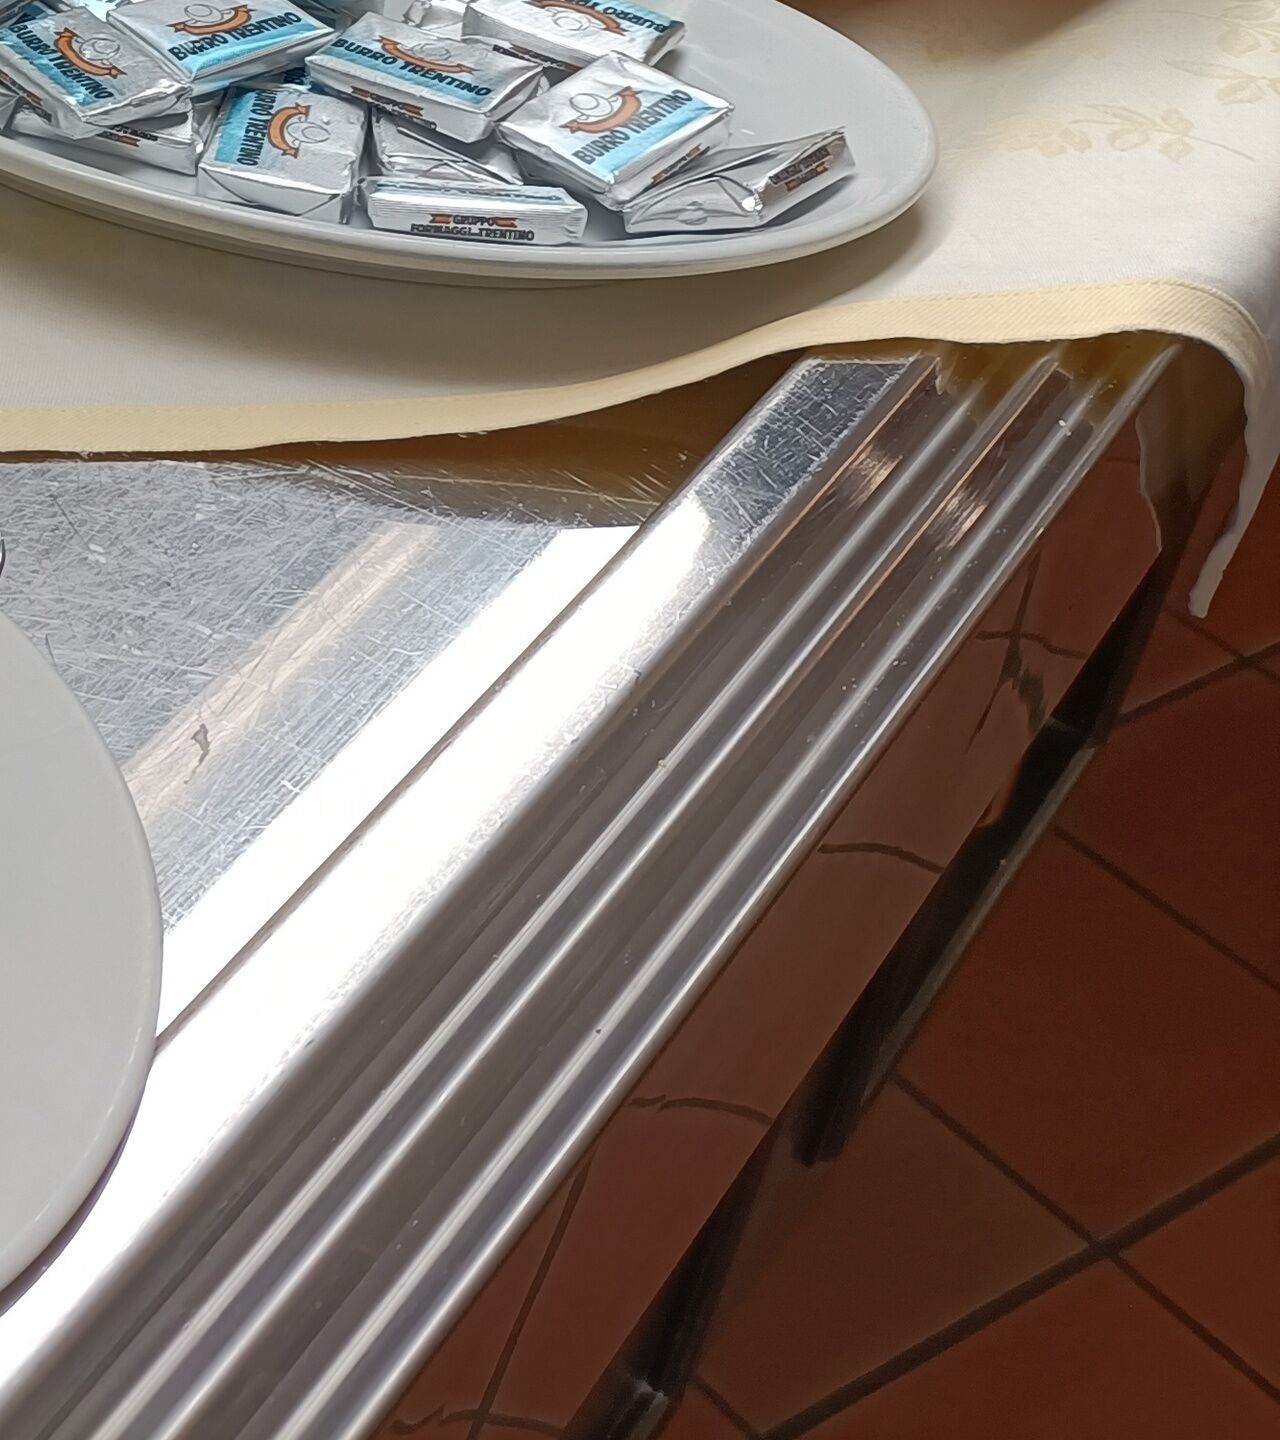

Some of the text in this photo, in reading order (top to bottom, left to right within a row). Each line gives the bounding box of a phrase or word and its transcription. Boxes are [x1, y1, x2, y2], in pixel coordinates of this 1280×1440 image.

[168, 11, 302, 61] BURRO TRENTINO
[603, 5, 670, 34] BURRO
[7, 24, 115, 100] BURRO TRENTINO
[332, 38, 493, 96] BURRO TRENTINO
[236, 116, 269, 166] TRENTINO
[572, 88, 694, 165] BURRO TRENTINO
[452, 214, 496, 228] GRUPPO
[478, 227, 535, 242] TRENTINO
